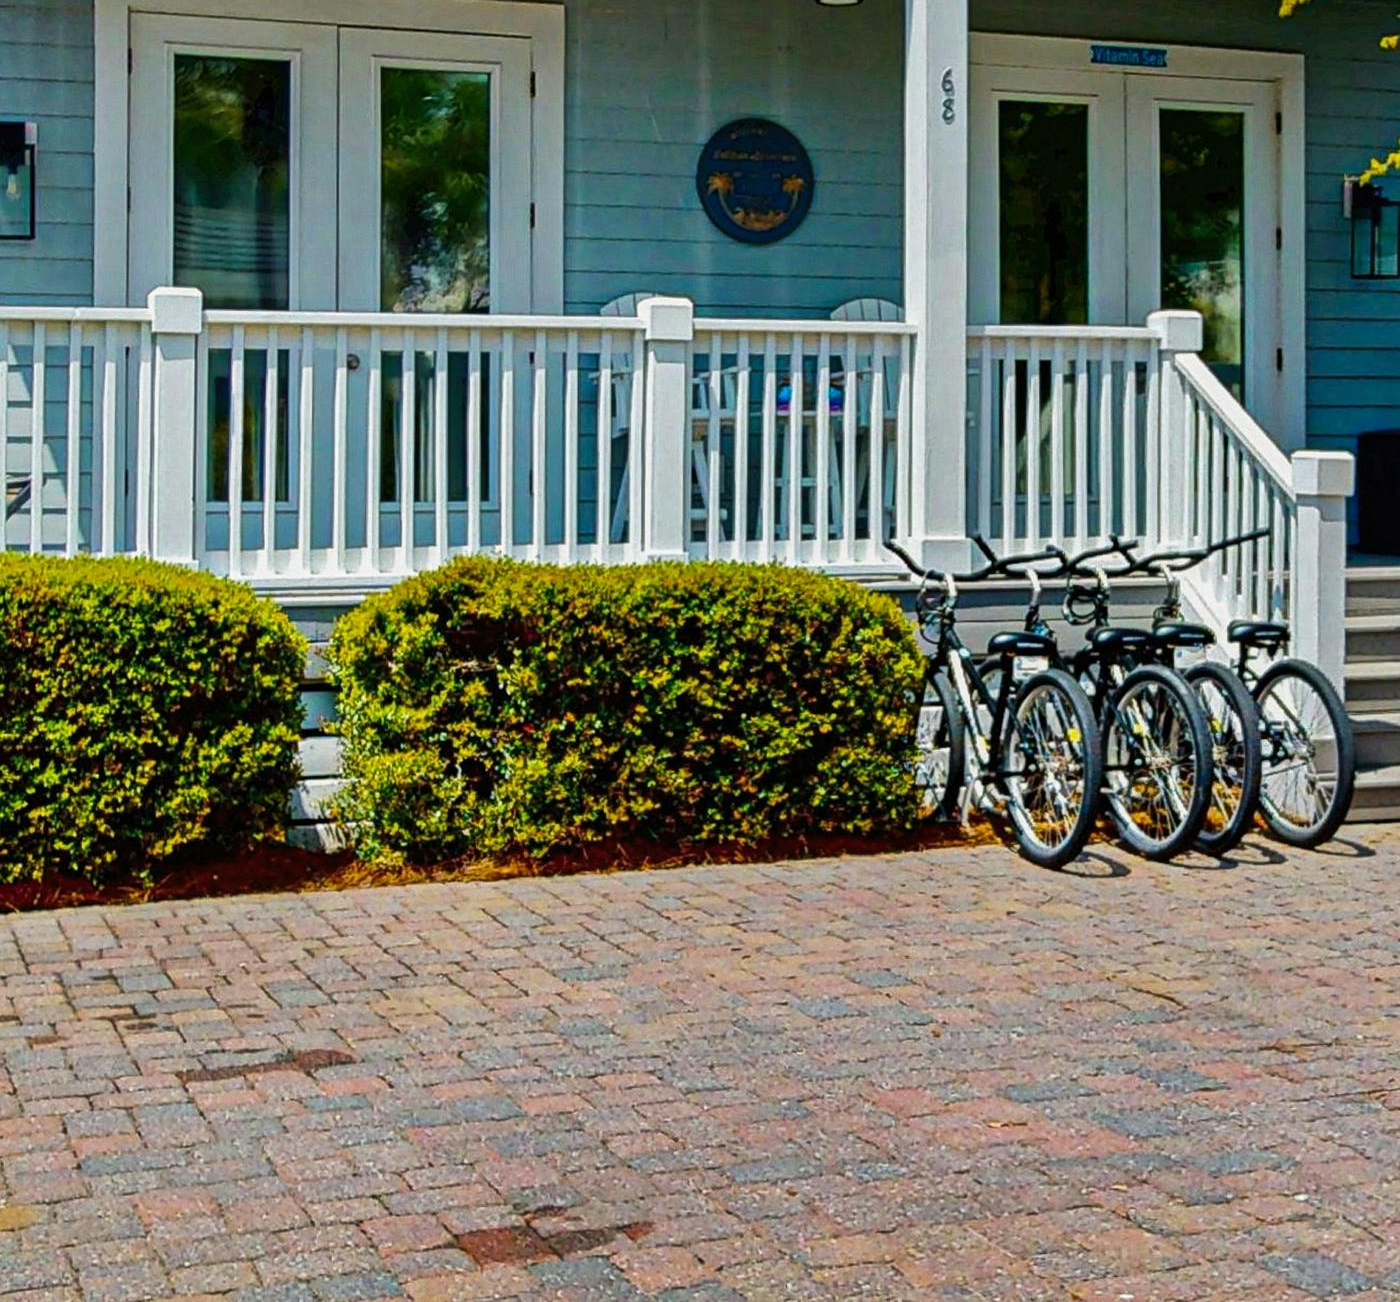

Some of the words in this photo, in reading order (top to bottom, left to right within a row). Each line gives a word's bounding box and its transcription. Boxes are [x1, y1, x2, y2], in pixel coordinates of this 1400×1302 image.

[1095, 47, 1139, 64] Vitamin
[1142, 50, 1164, 66] Sea
[941, 67, 955, 125] 68
